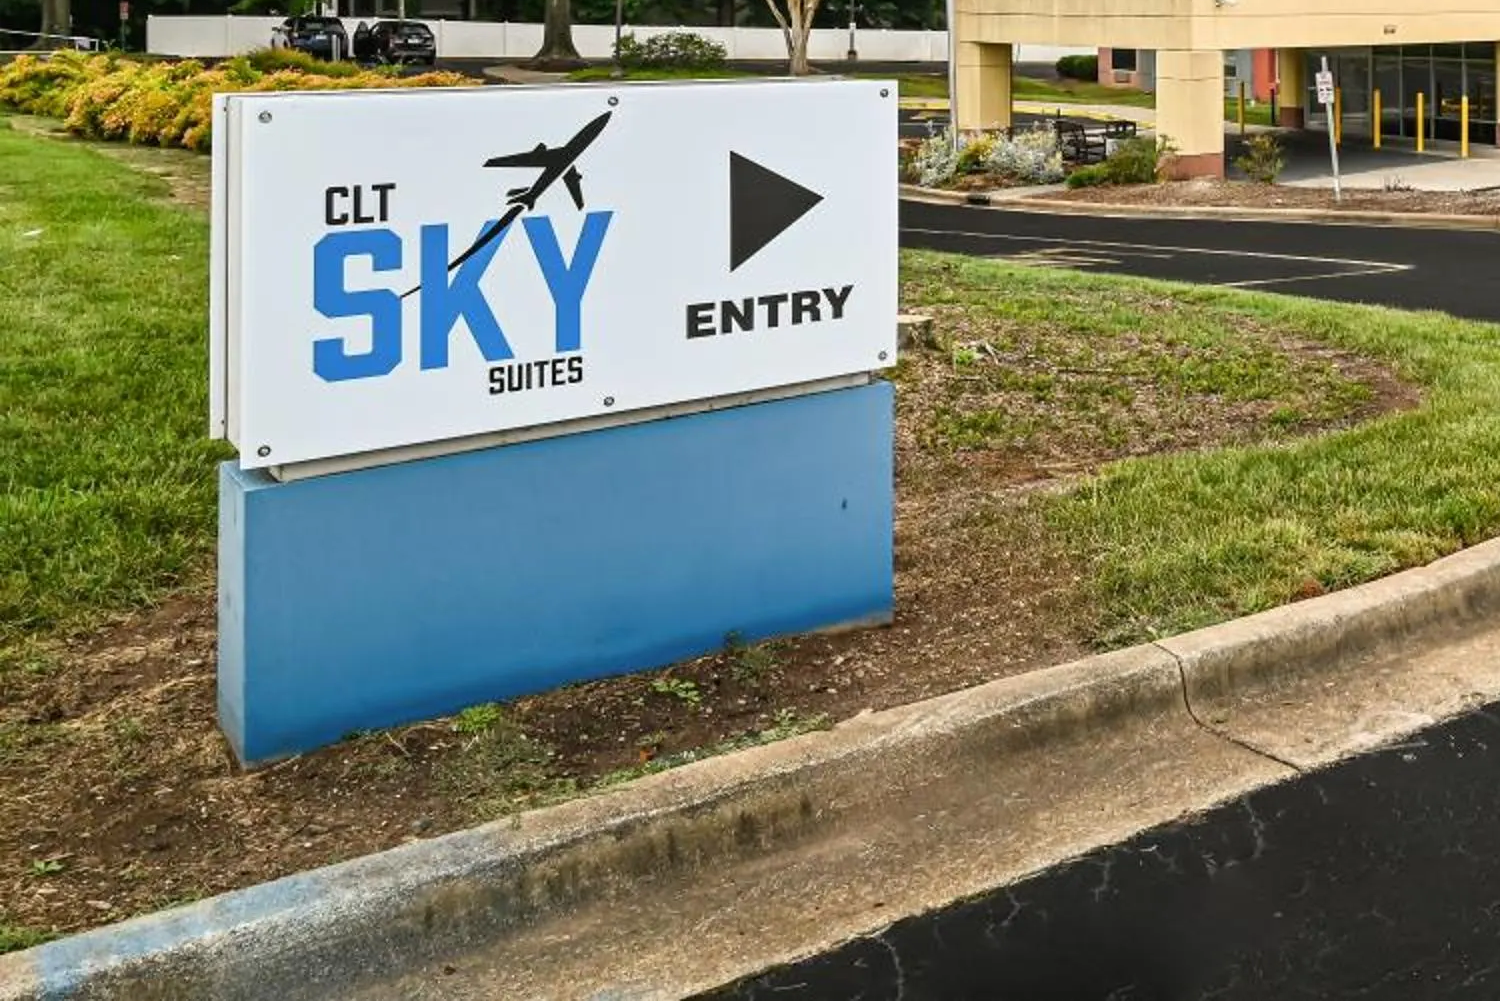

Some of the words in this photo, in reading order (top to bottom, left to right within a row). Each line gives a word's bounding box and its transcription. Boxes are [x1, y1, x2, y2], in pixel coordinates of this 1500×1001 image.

[325, 182, 396, 225] CLT
[313, 210, 615, 383] SKY
[686, 284, 854, 339] ENTRY
[489, 356, 583, 395] SUITES
